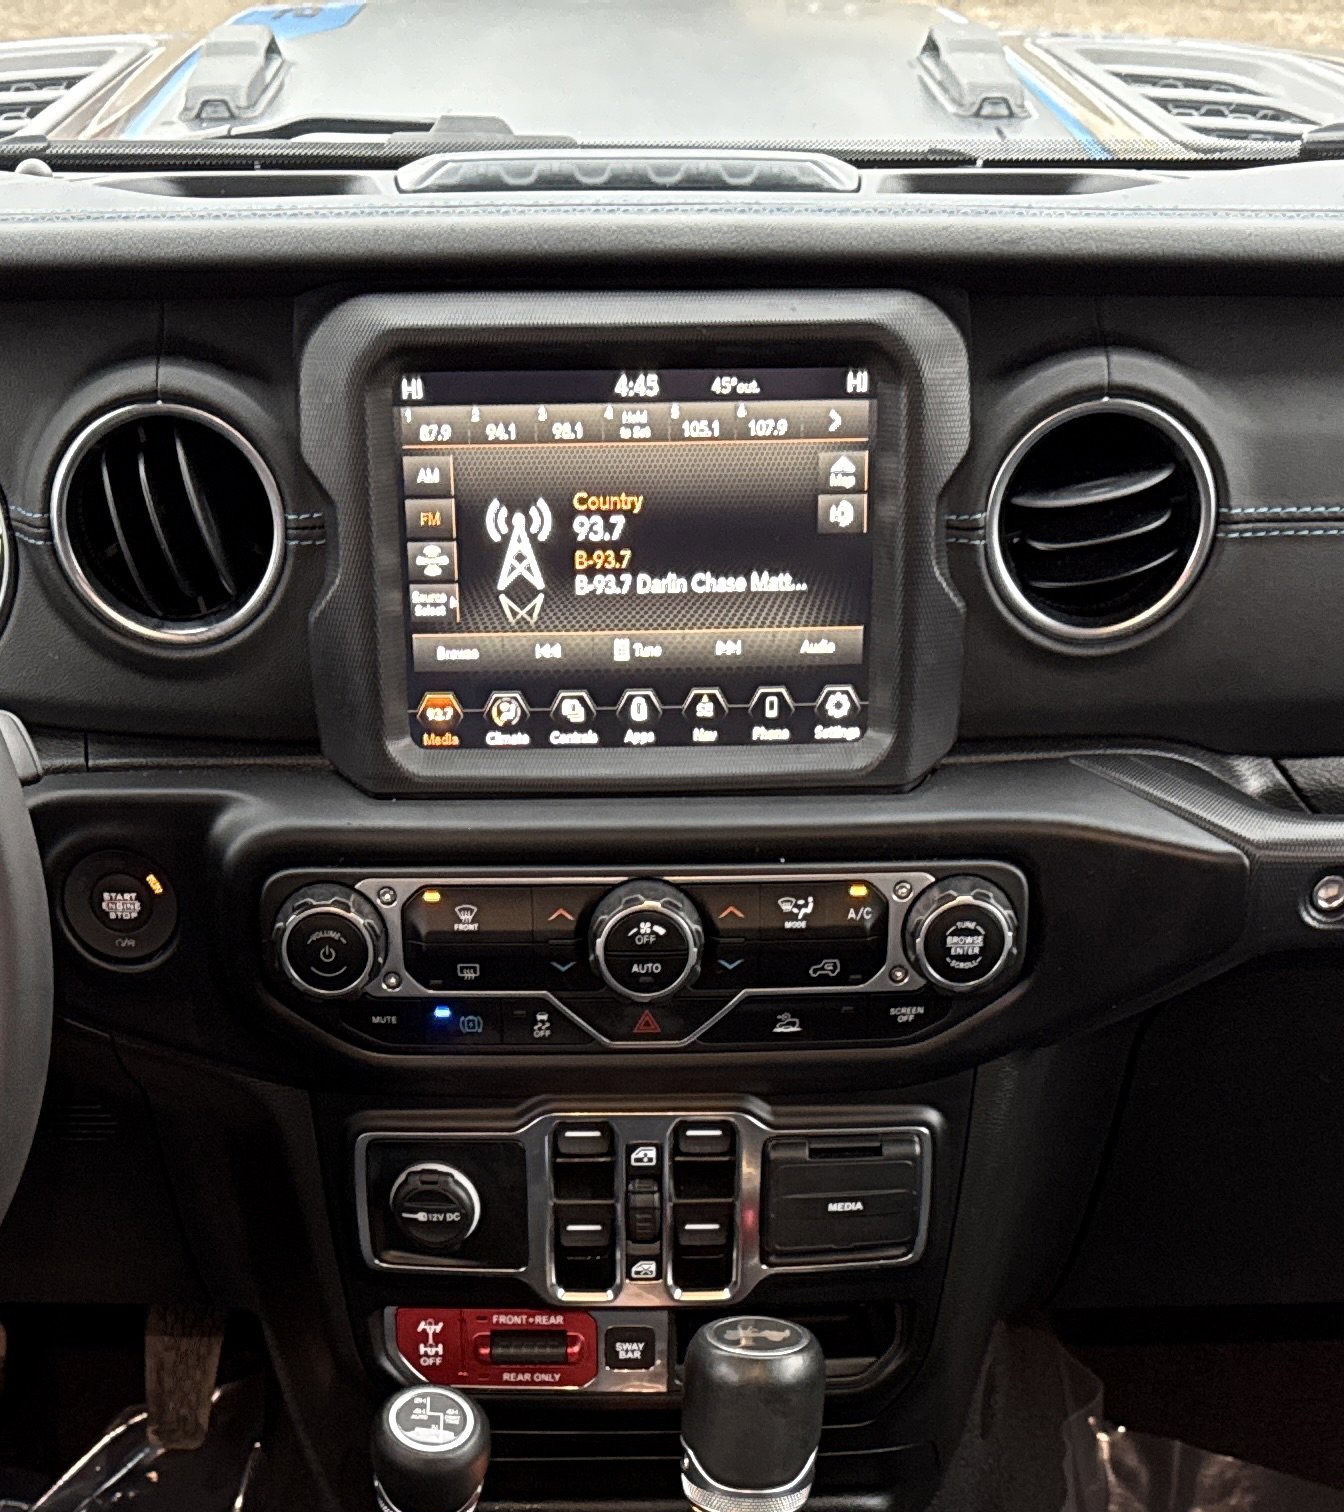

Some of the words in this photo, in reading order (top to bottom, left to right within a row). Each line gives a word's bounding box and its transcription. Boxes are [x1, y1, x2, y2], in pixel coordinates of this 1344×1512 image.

[614, 371, 660, 397] 4:45
[682, 420, 720, 438] 105.1
[748, 419, 788, 437] 107.9
[417, 467, 440, 484] AM
[573, 492, 644, 514] Country
[420, 511, 441, 526] FM
[573, 515, 625, 541] 93.7
[574, 549, 631, 569] B-93.7
[575, 573, 632, 595] B-93.7
[691, 571, 747, 593] Chase
[800, 638, 836, 653] Audio
[486, 730, 530, 745] Climate
[550, 730, 598, 744] Controls
[624, 728, 655, 745] Apps
[693, 727, 717, 741] Nav
[752, 726, 790, 741] Phone
[814, 725, 860, 740] Settings
[423, 732, 459, 746] Media
[103, 892, 137, 901] START
[102, 902, 141, 912] ENGINE
[109, 912, 138, 920] STOP
[847, 907, 872, 920] A/C
[454, 922, 479, 931] FRONT
[784, 921, 807, 929] MODE
[956, 921, 977, 930] TUNE
[635, 935, 656, 945] OFF
[946, 935, 984, 945] BROWSE
[950, 946, 980, 955] ENTER
[631, 963, 662, 974] AUTO
[889, 1006, 925, 1015] SCREEN
[372, 1015, 397, 1025] MUTE
[897, 1015, 915, 1023] OFF
[533, 1029, 551, 1038] OFF
[827, 1201, 864, 1212] MEDIA
[427, 1213, 444, 1222] 12V
[446, 1212, 461, 1222] DC
[616, 1342, 645, 1351] SWAY
[618, 1350, 641, 1359] BAR
[420, 1356, 443, 1367] OFF
[502, 1373, 533, 1382] REAR
[534, 1372, 561, 1382] ONLY
